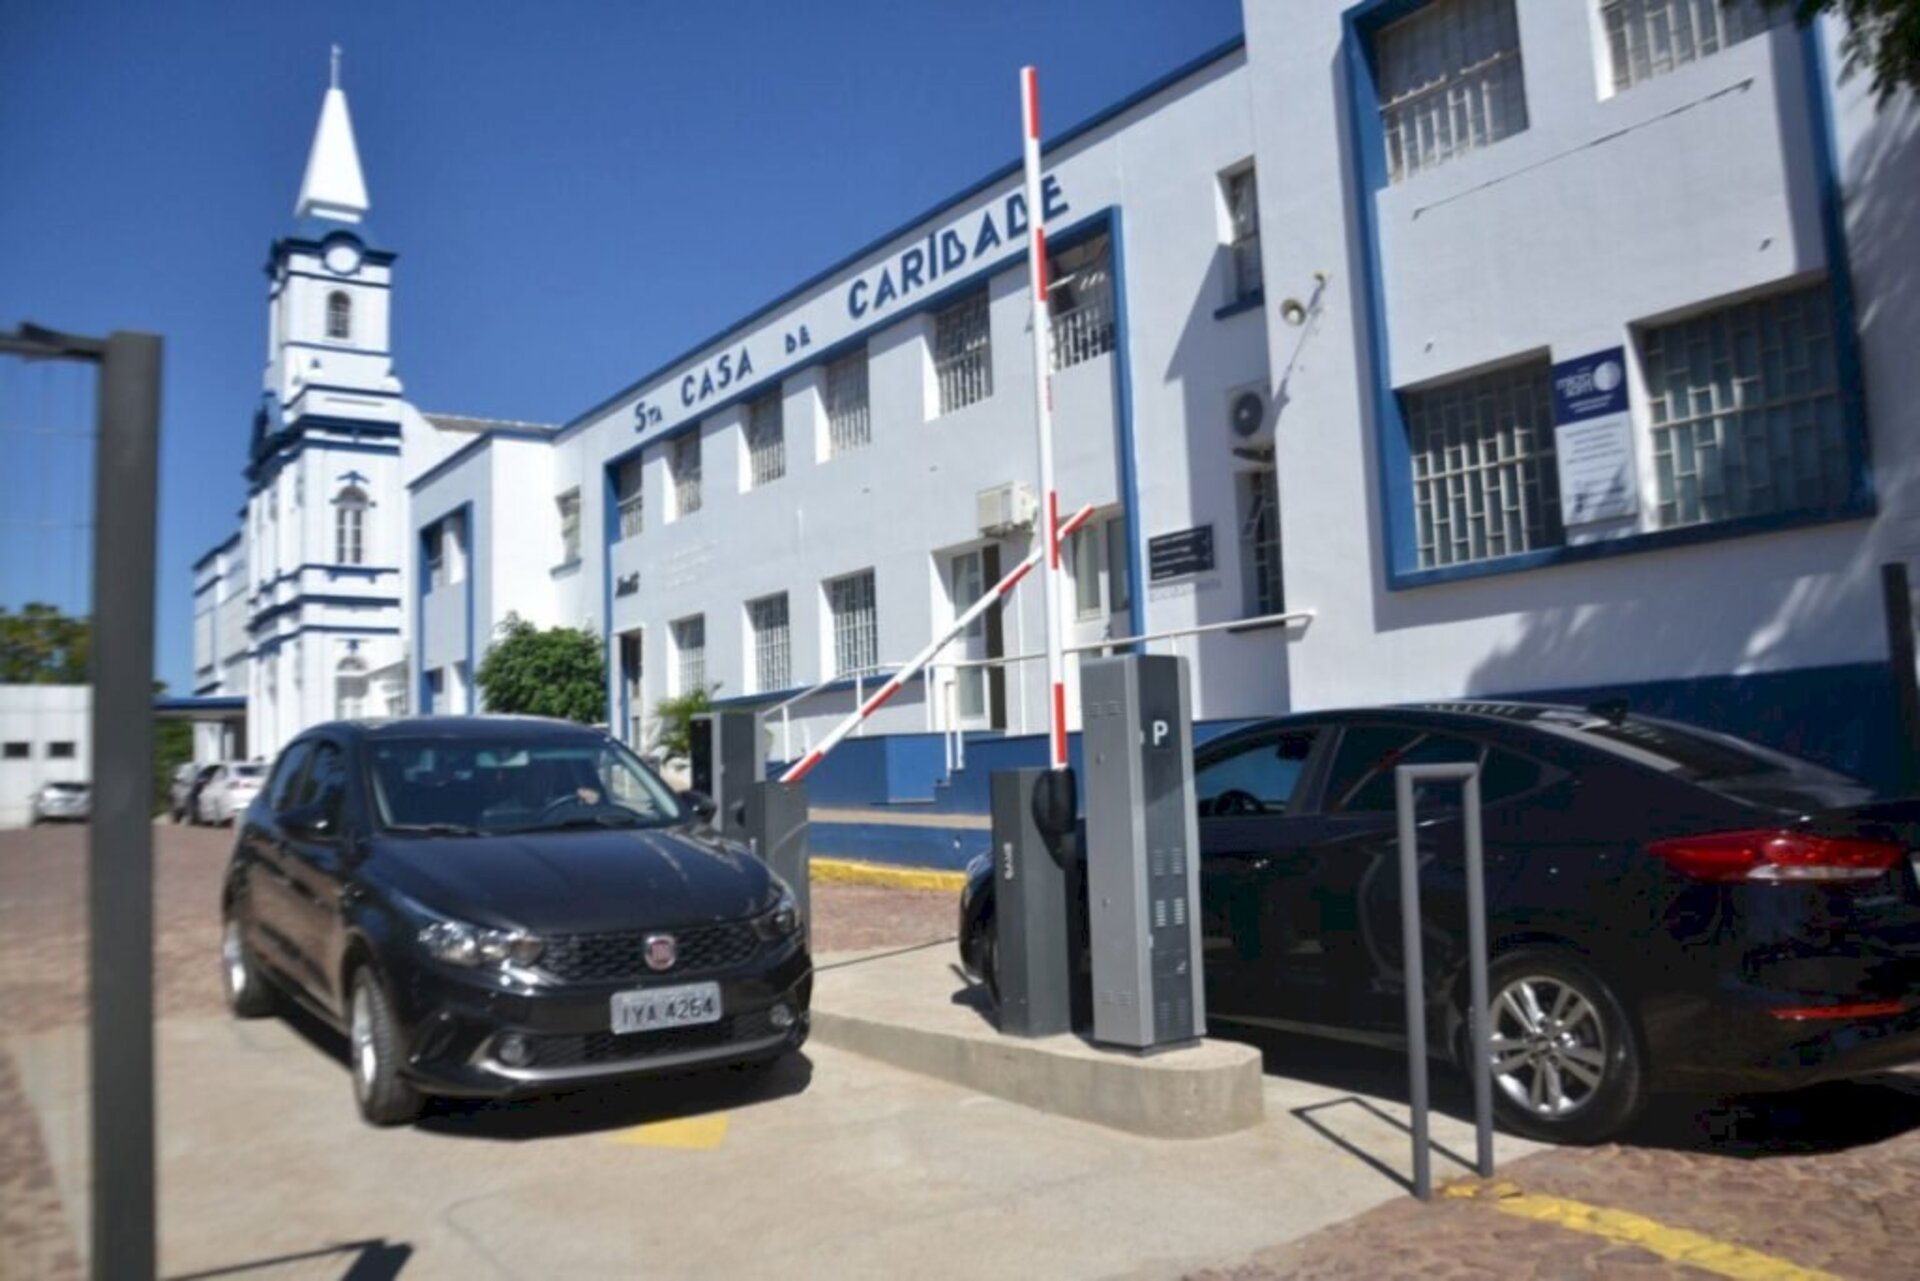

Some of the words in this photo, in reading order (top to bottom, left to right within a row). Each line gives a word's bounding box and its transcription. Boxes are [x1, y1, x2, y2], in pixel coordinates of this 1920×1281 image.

[681, 346, 754, 407] CASA
[785, 324, 811, 354] DE
[848, 174, 1070, 320] CARIDADE
[1153, 720, 1169, 746] P
[622, 1005, 657, 1025] IYA
[665, 997, 714, 1020] 4264
